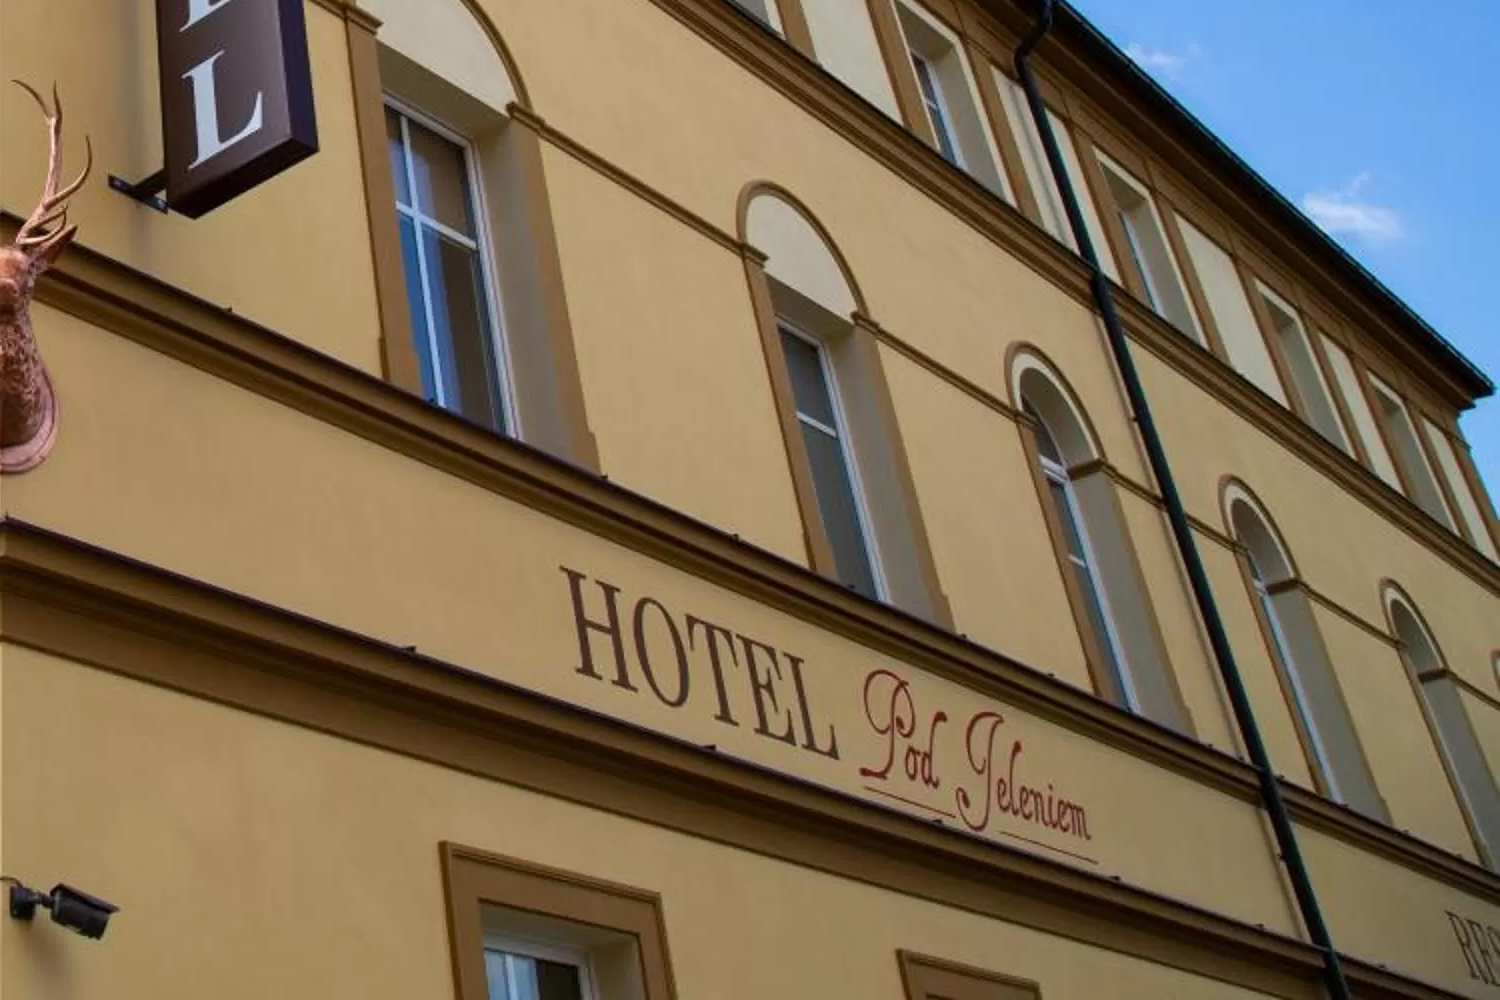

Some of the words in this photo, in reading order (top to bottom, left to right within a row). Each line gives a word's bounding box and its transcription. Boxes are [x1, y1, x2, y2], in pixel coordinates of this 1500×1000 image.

[559, 565, 841, 761] HOTEL
[858, 668, 948, 791] Pod
[955, 710, 1093, 841] Jeleniem
